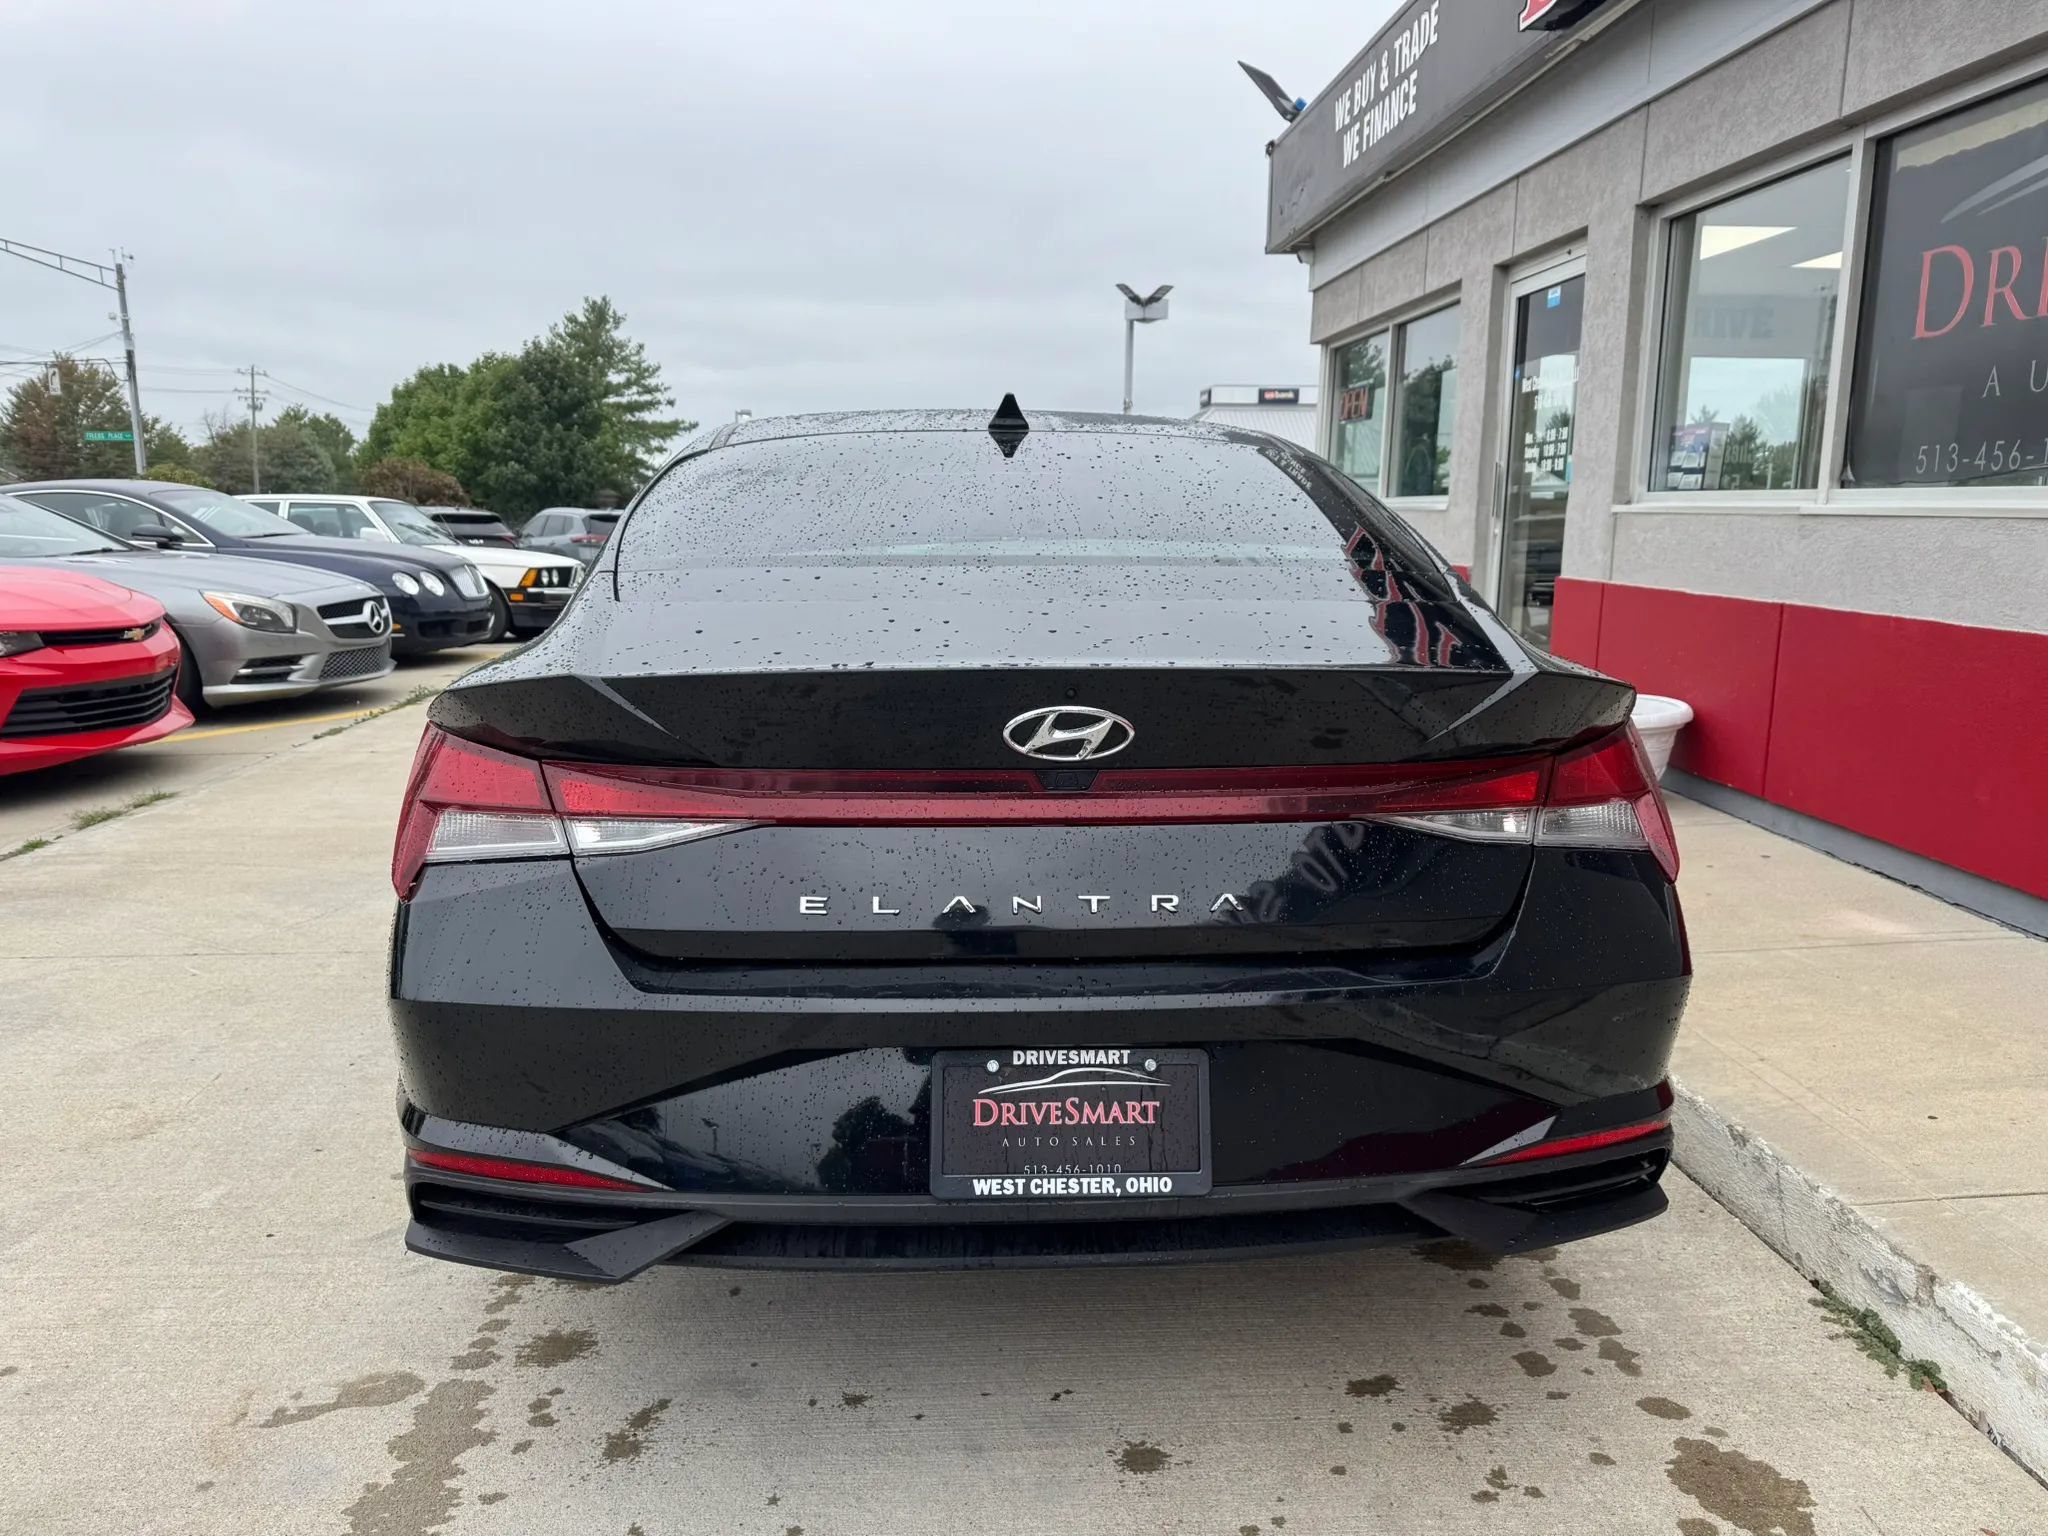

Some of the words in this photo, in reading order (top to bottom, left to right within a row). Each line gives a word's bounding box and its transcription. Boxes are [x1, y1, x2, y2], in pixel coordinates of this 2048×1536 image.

[1335, 88, 1351, 132] WE
[1353, 62, 1377, 116] BUY
[1379, 52, 1389, 91] &
[1394, 0, 1439, 77] TRADE
[1343, 125, 1359, 168] WE
[1362, 70, 1418, 152] FINANCE
[799, 893, 1244, 915] ELANTRA
[1013, 1050, 1131, 1065] DRIVESMART
[1002, 1136, 1059, 1147] AUTO
[1072, 1135, 1136, 1147] SALES
[1023, 1163, 1122, 1175] 513-456-1010
[973, 1178, 1025, 1195] WEST
[1029, 1177, 1122, 1197] CHESTER,
[1125, 1176, 1173, 1193] OHIO
